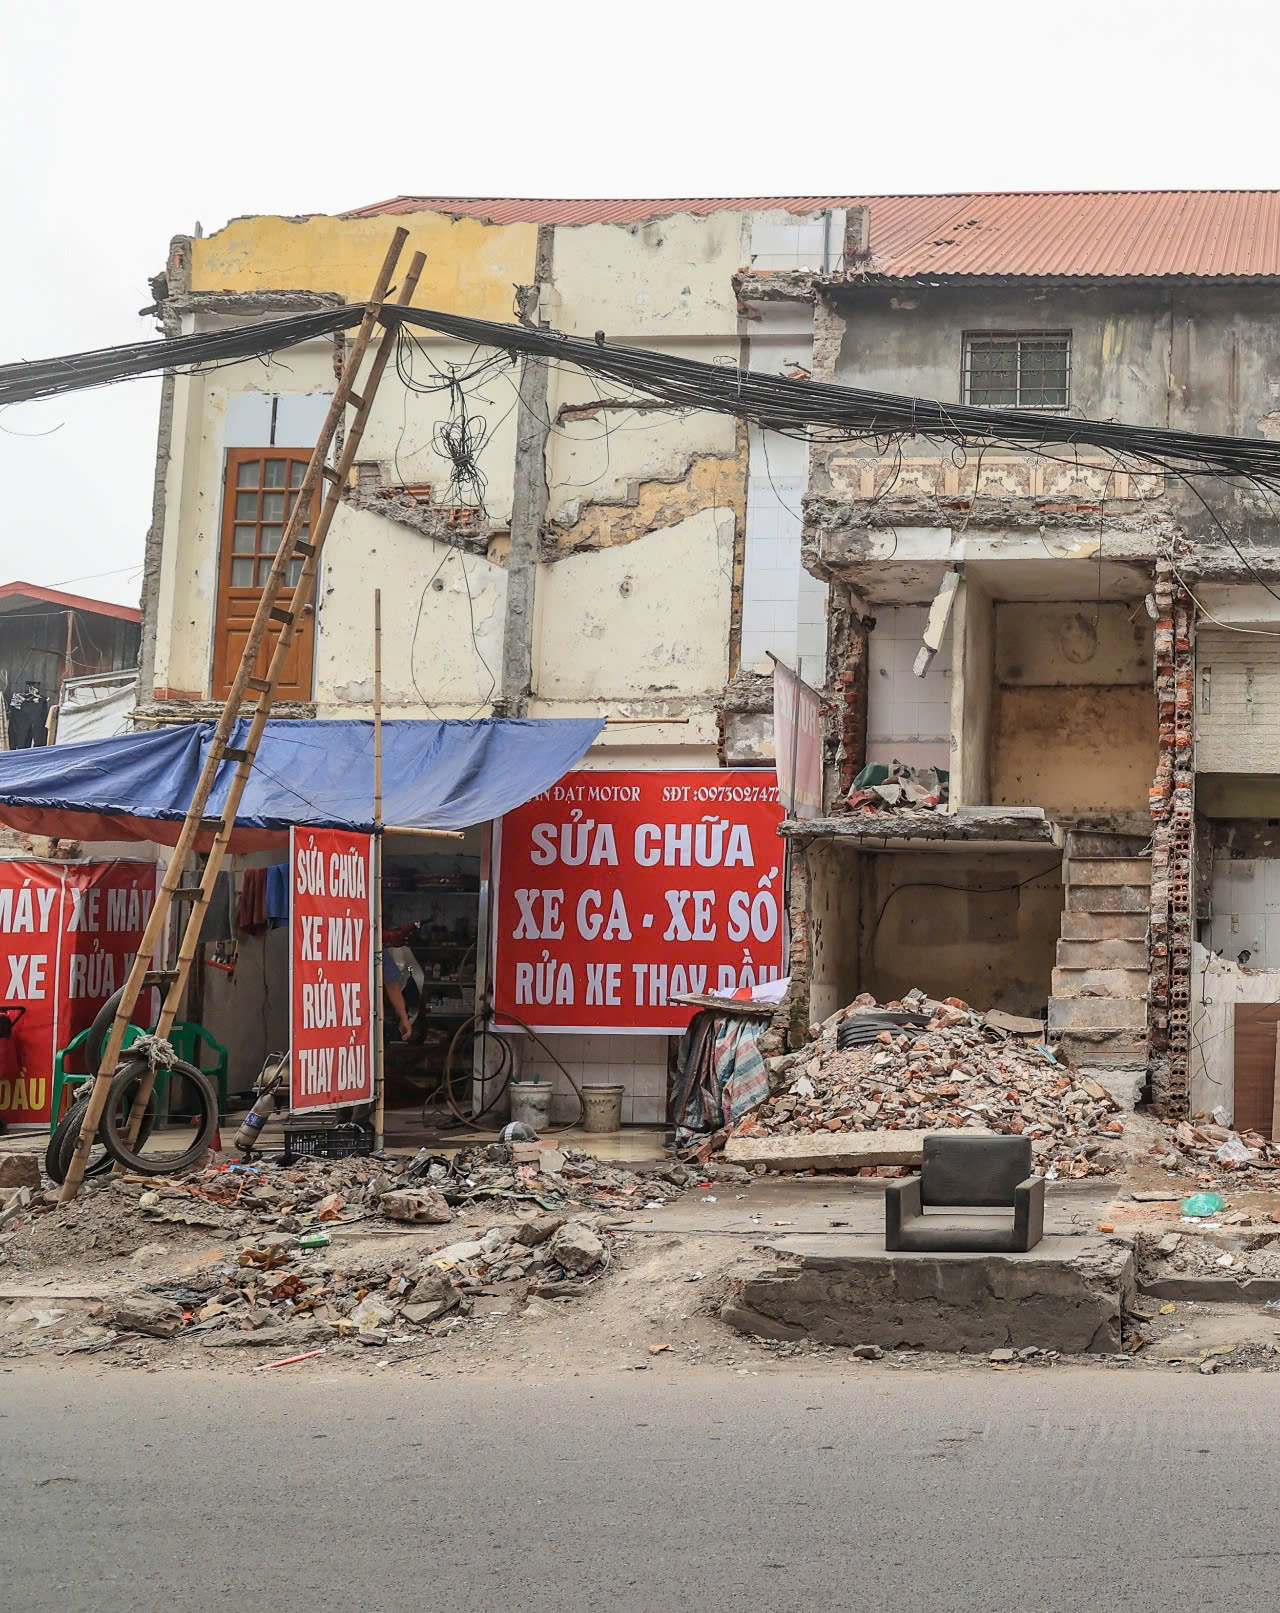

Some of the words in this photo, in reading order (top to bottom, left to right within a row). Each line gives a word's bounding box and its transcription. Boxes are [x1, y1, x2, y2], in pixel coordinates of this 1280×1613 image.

[554, 786, 585, 804] ĐẠT
[587, 786, 641, 802] MOTOR
[662, 786, 691, 802] SĐT
[297, 835, 325, 896] SỬA
[329, 847, 366, 899] CHỮA
[530, 808, 619, 867] SỬA
[634, 815, 755, 868] CHỮA
[66, 887, 99, 933] XE
[107, 880, 153, 932] MÁY
[301, 915, 323, 961] XE
[327, 908, 363, 961] MÁY
[512, 888, 565, 941] XE
[576, 888, 633, 942] GA
[663, 889, 717, 942] XE
[727, 866, 779, 943] SỐ
[5, 954, 48, 1000] XE
[69, 938, 118, 999] RỬA
[303, 967, 338, 1029] RỬA
[340, 983, 362, 1027] XE
[515, 949, 575, 1006] RỬA
[586, 963, 622, 1006] XE
[298, 1047, 335, 1096] THAY
[338, 1029, 366, 1091] DẦU
